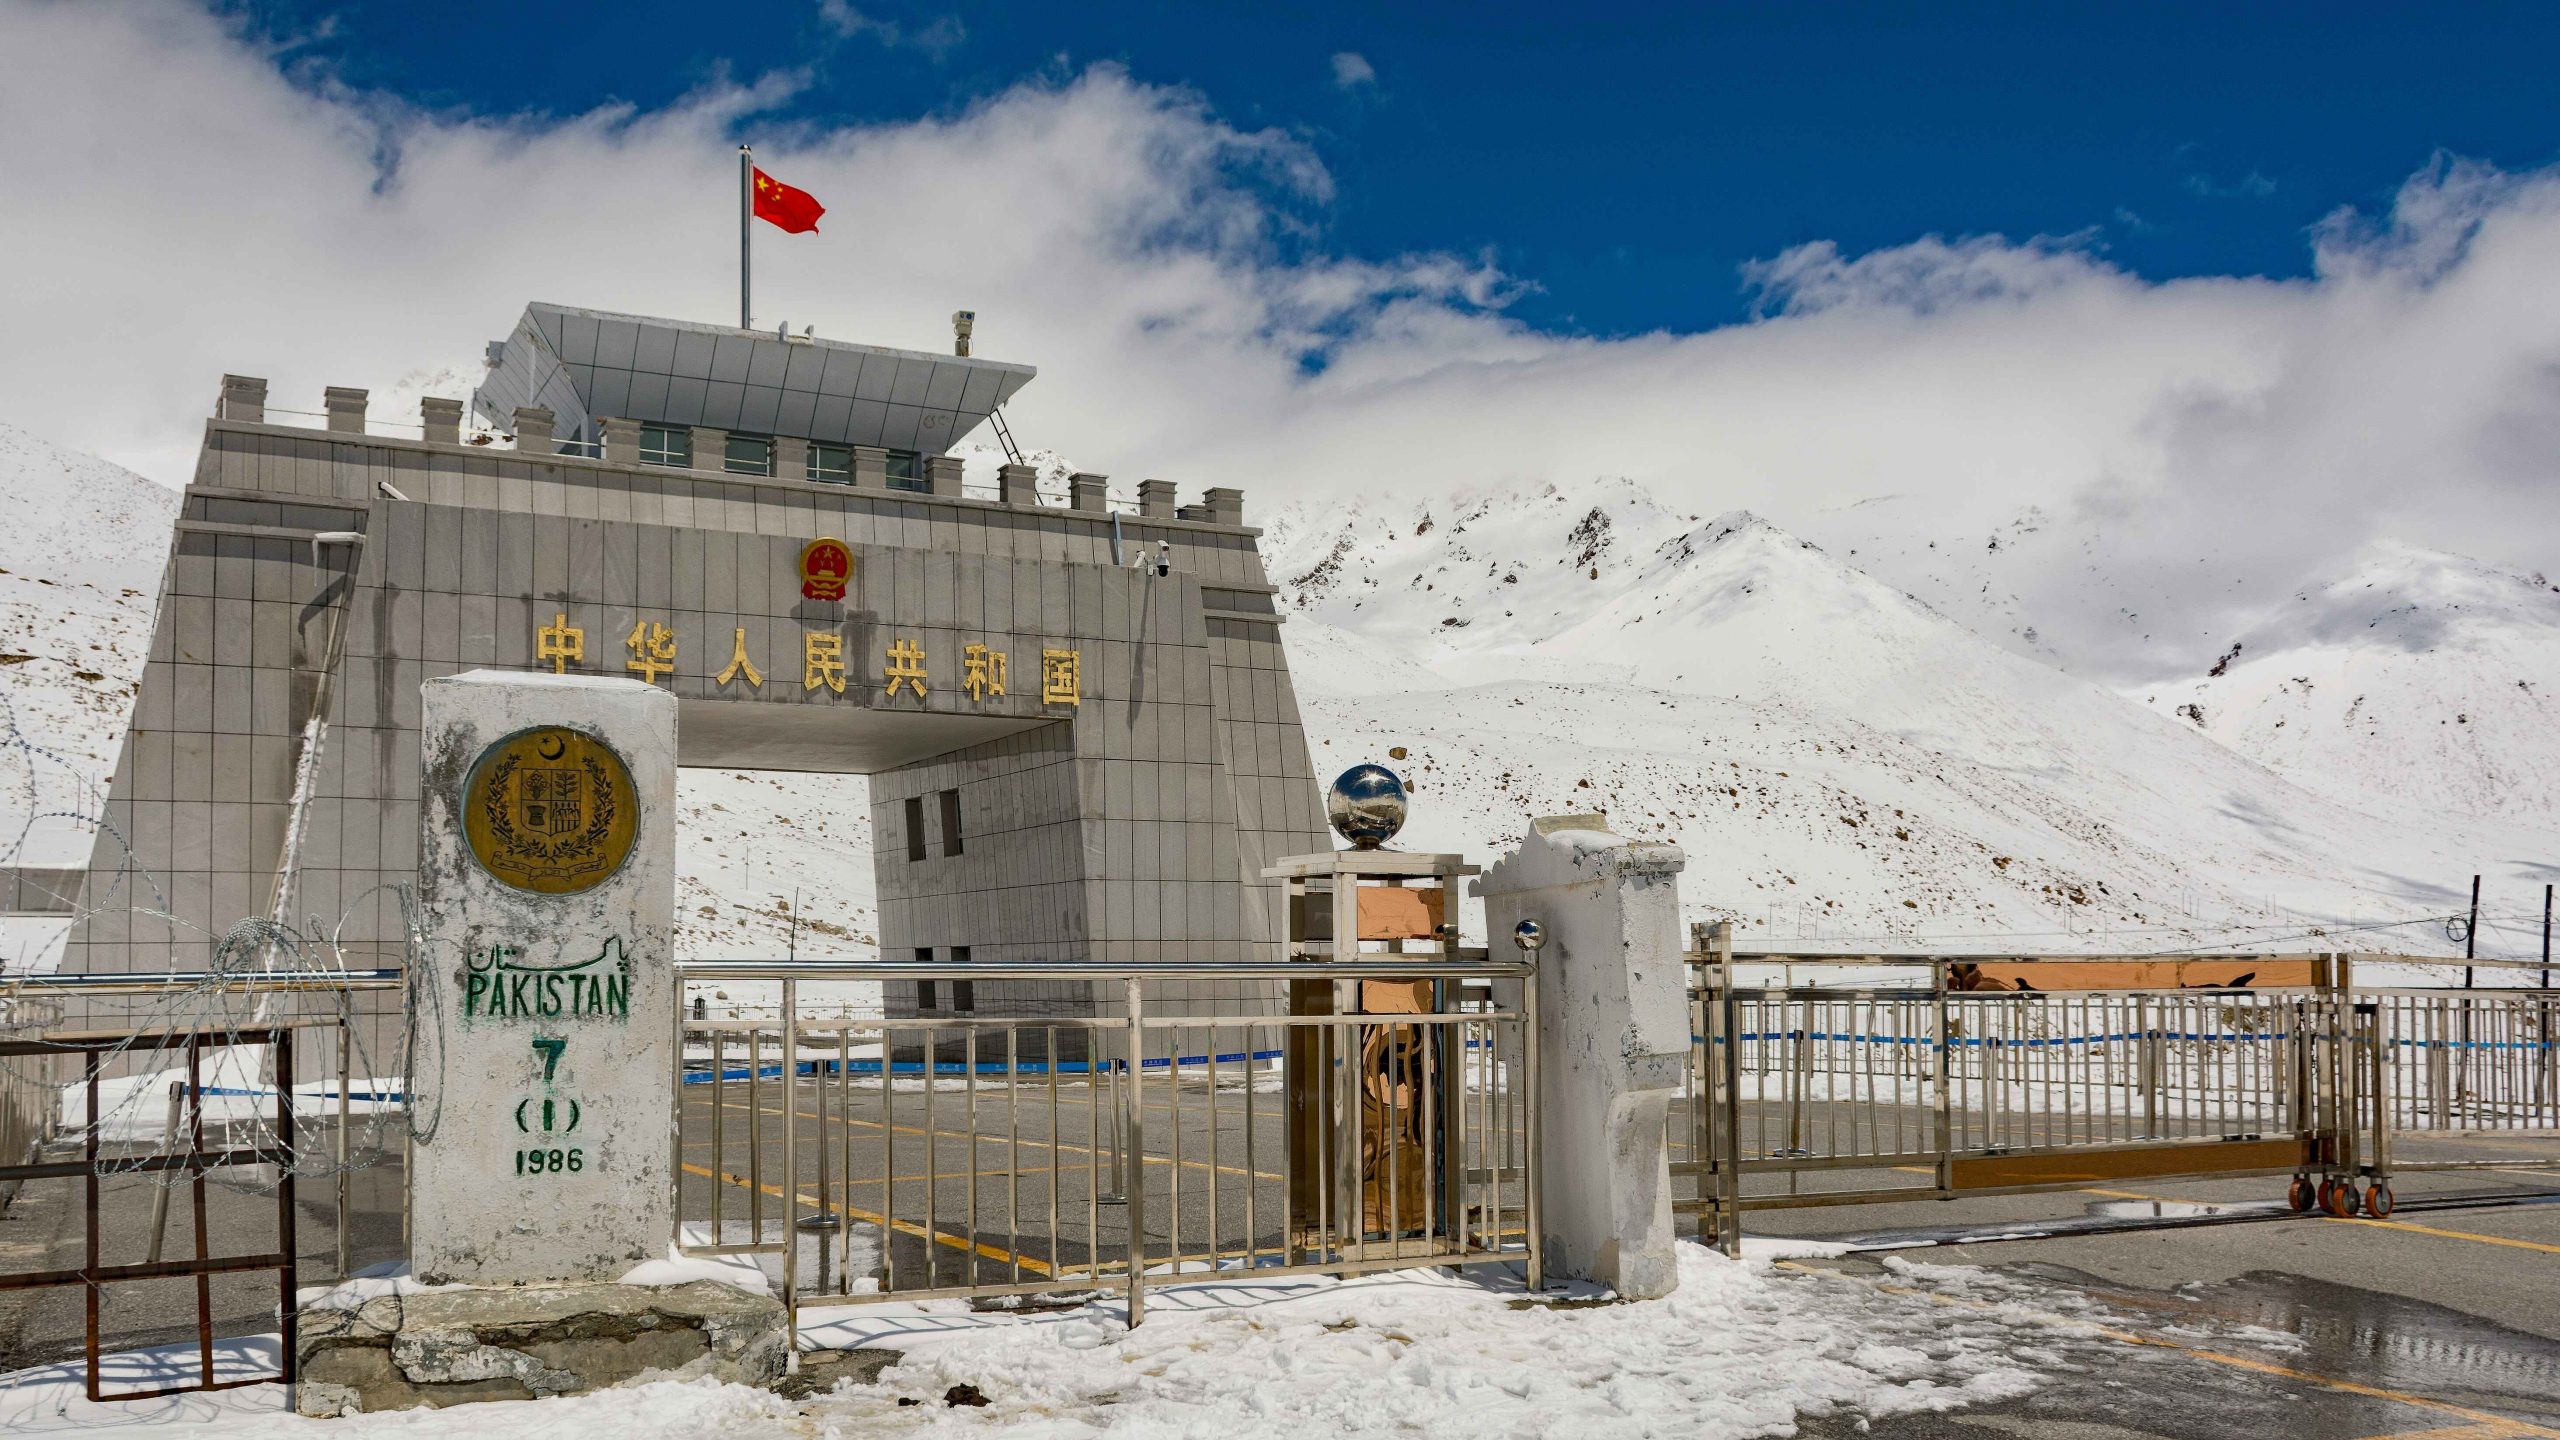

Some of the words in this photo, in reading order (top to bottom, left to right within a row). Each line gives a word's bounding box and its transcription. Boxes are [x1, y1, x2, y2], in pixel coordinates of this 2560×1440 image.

[536, 613, 1080, 707] 中华人民共和国
[467, 974, 628, 1016] PAKISTAN
[532, 1039, 567, 1081] 7
[516, 1148, 584, 1176] 1986
